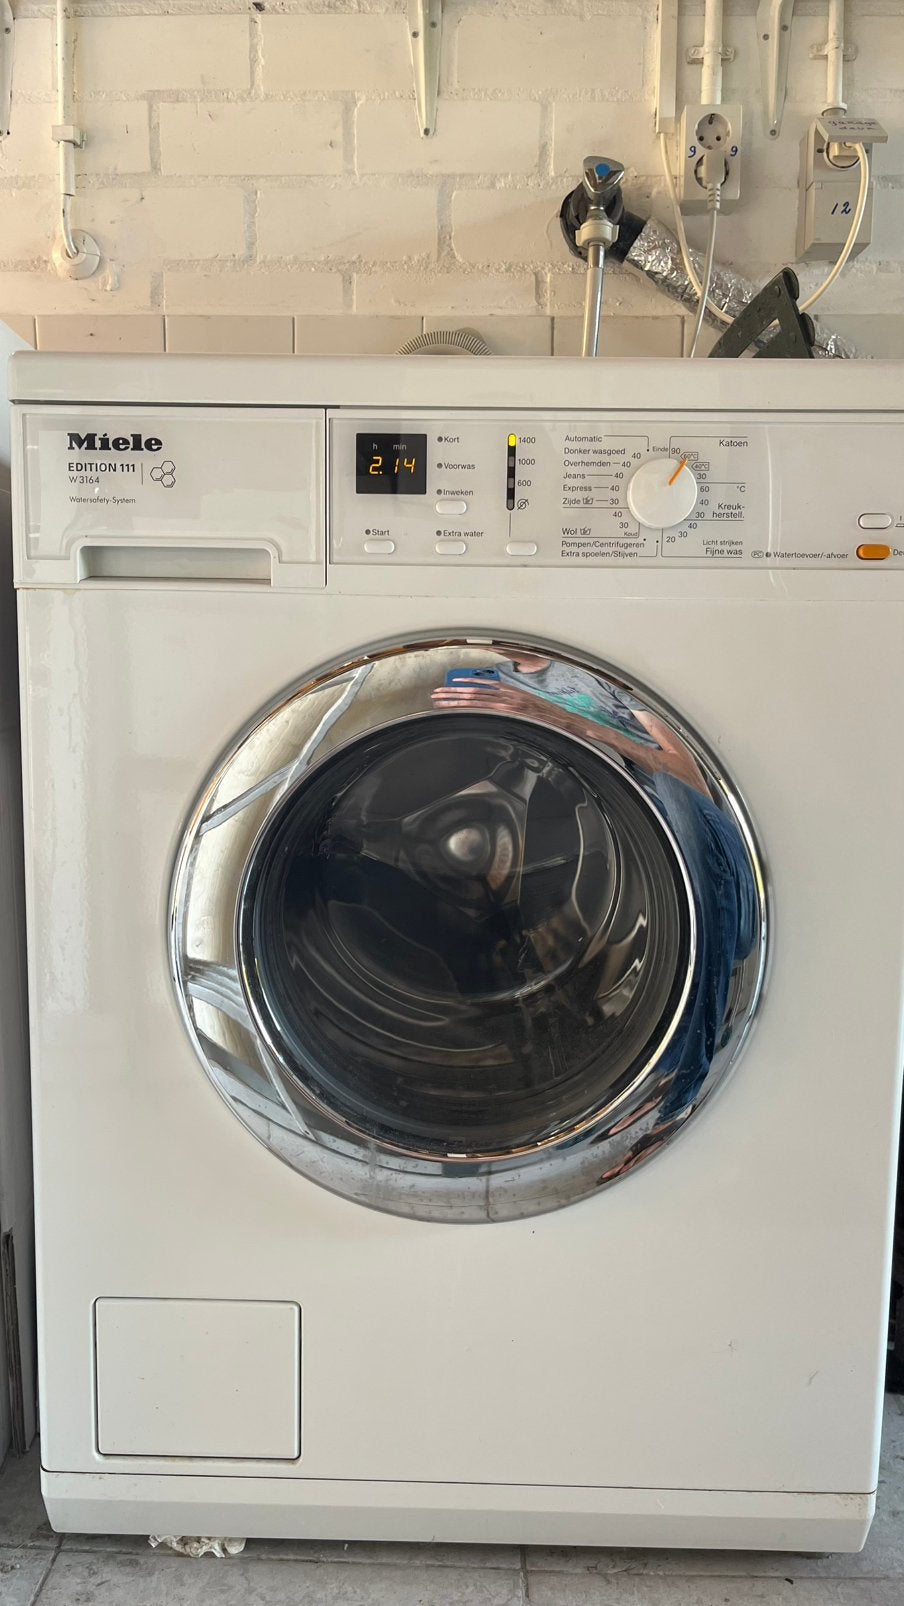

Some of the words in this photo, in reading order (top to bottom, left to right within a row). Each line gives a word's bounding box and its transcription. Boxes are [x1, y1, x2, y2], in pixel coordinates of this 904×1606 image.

[688, 146, 696, 158] 9
[730, 146, 738, 156] 9
[831, 202, 851, 214] 12
[67, 432, 162, 452] Miele
[592, 448, 626, 456] wasgoed
[68, 462, 117, 472] EDITION
[120, 464, 135, 472] 111
[79, 476, 100, 484] 3164
[69, 496, 136, 504] Watersafety-System
[562, 540, 644, 548] Pompen/Centrifugeren
[582, 550, 638, 558] spoelen/Stijven
[706, 548, 724, 556] Fijne
